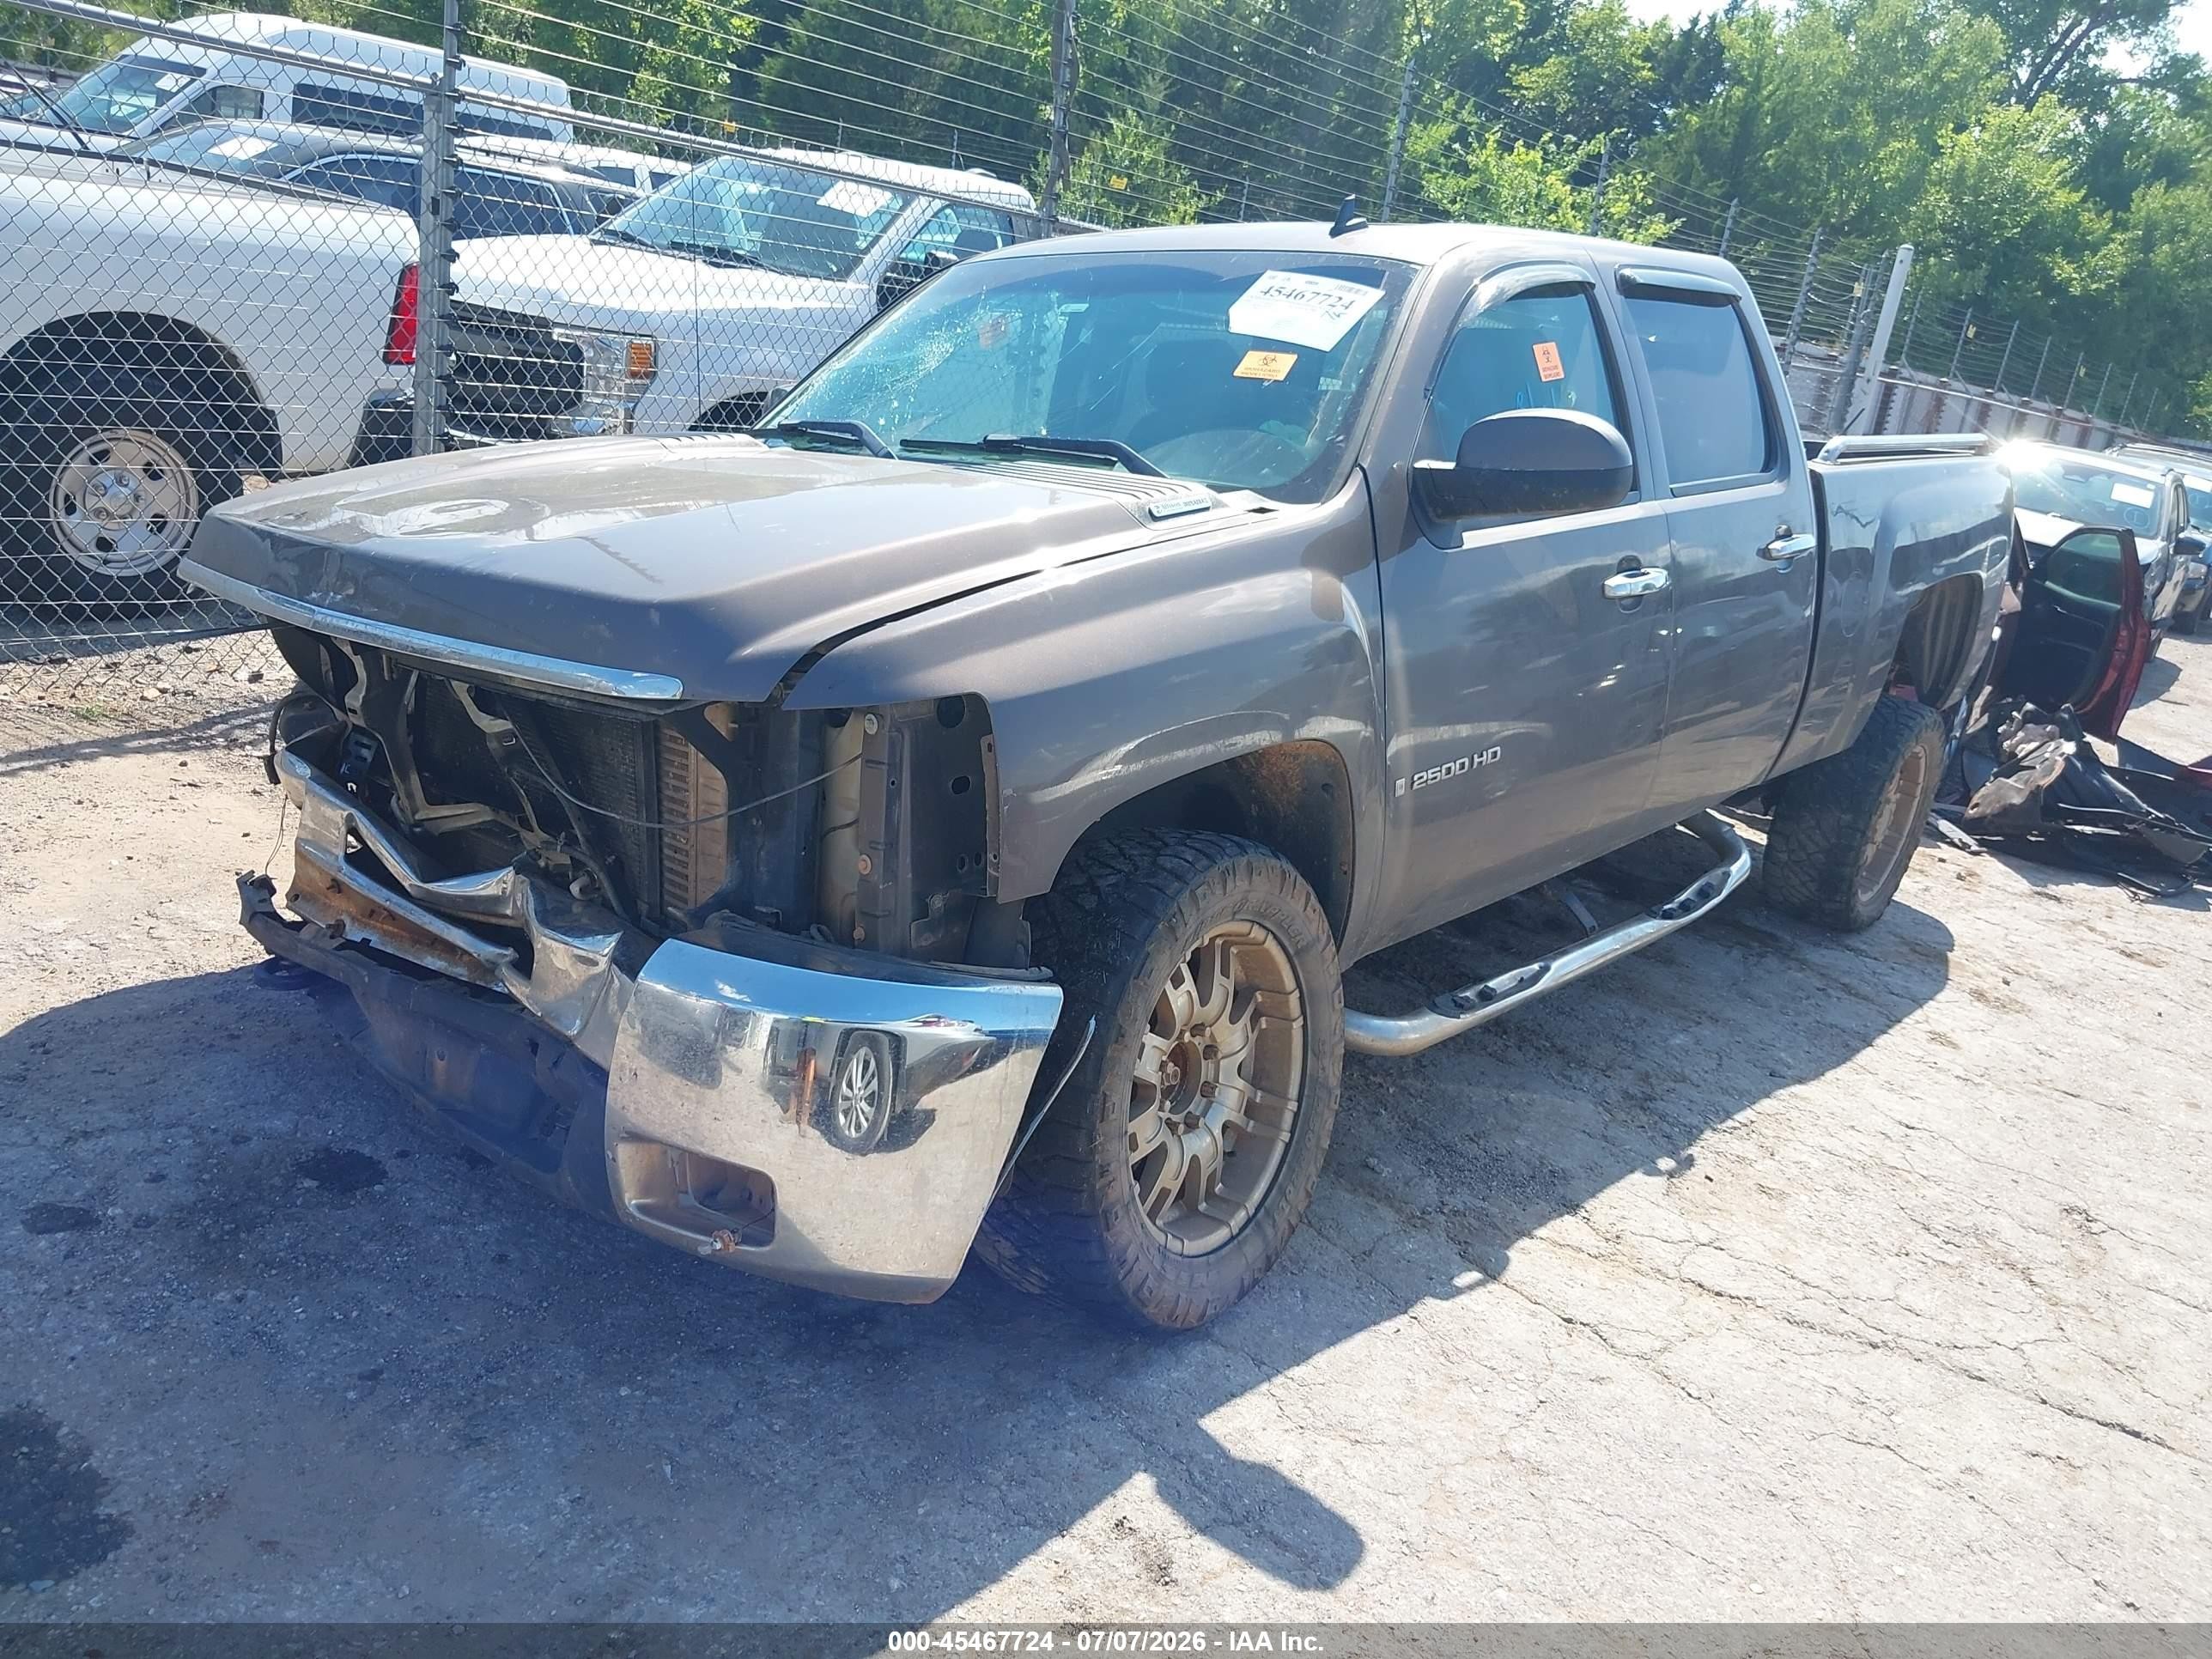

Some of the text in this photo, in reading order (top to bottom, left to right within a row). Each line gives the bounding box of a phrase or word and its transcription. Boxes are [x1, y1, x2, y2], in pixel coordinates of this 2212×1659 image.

[1259, 284, 1357, 311] 45467724
[1412, 745, 1501, 791] 2500 HD
